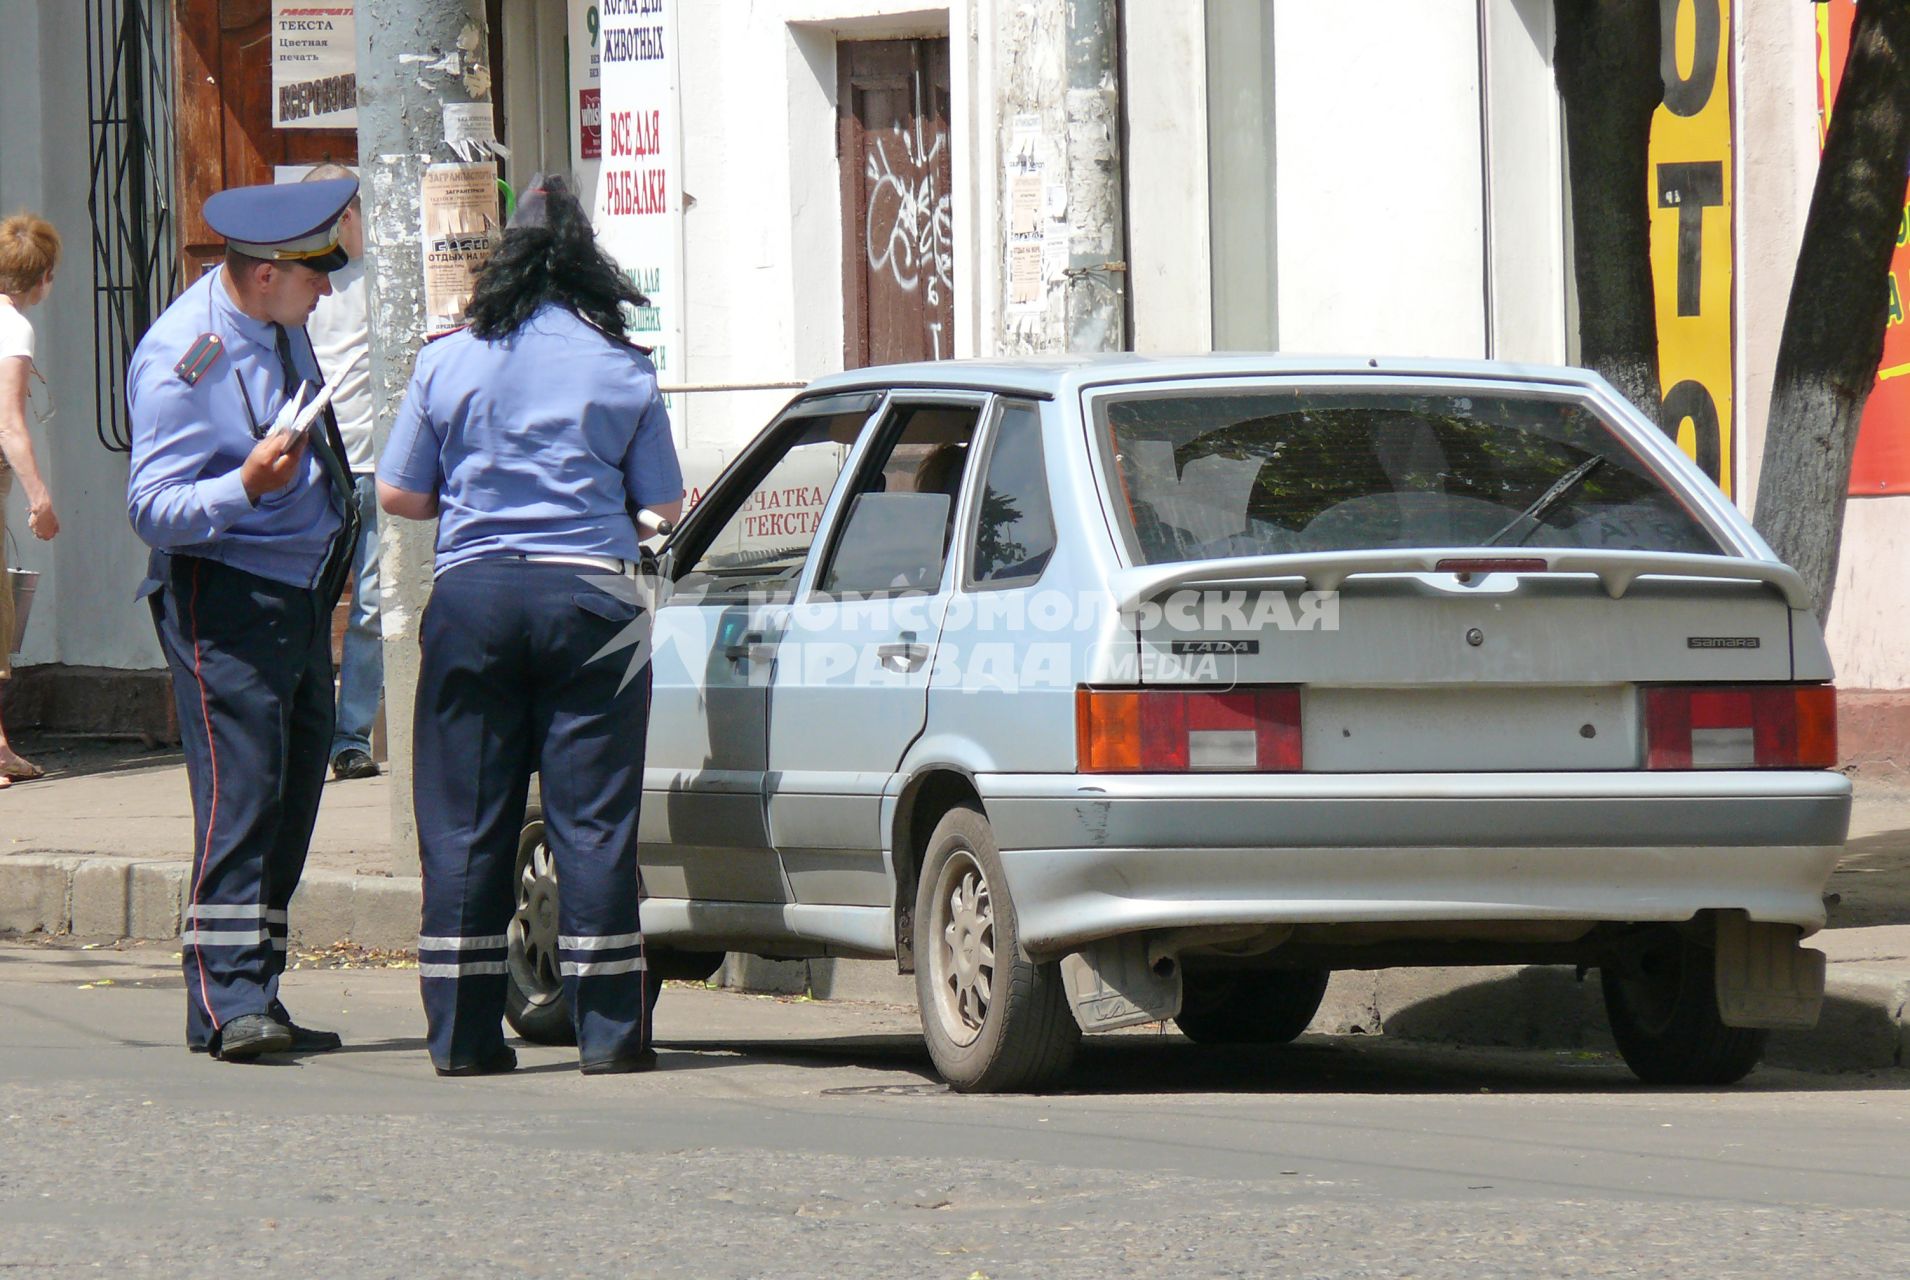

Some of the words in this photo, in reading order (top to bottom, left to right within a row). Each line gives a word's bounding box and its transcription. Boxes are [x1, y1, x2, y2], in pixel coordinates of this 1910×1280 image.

[279, 20, 334, 31] ТЕКСТА
[279, 38, 328, 48] Цветная
[603, 26, 665, 62] ЖИВОТНЫХ
[610, 111, 632, 156] ВСЕ
[634, 110, 660, 162] ДЛЯ
[606, 169, 666, 216] РЫБАЛКИ
[428, 253, 463, 263] ОТДЫХ
[466, 252, 478, 260] НА
[1181, 640, 1250, 652] LADA
